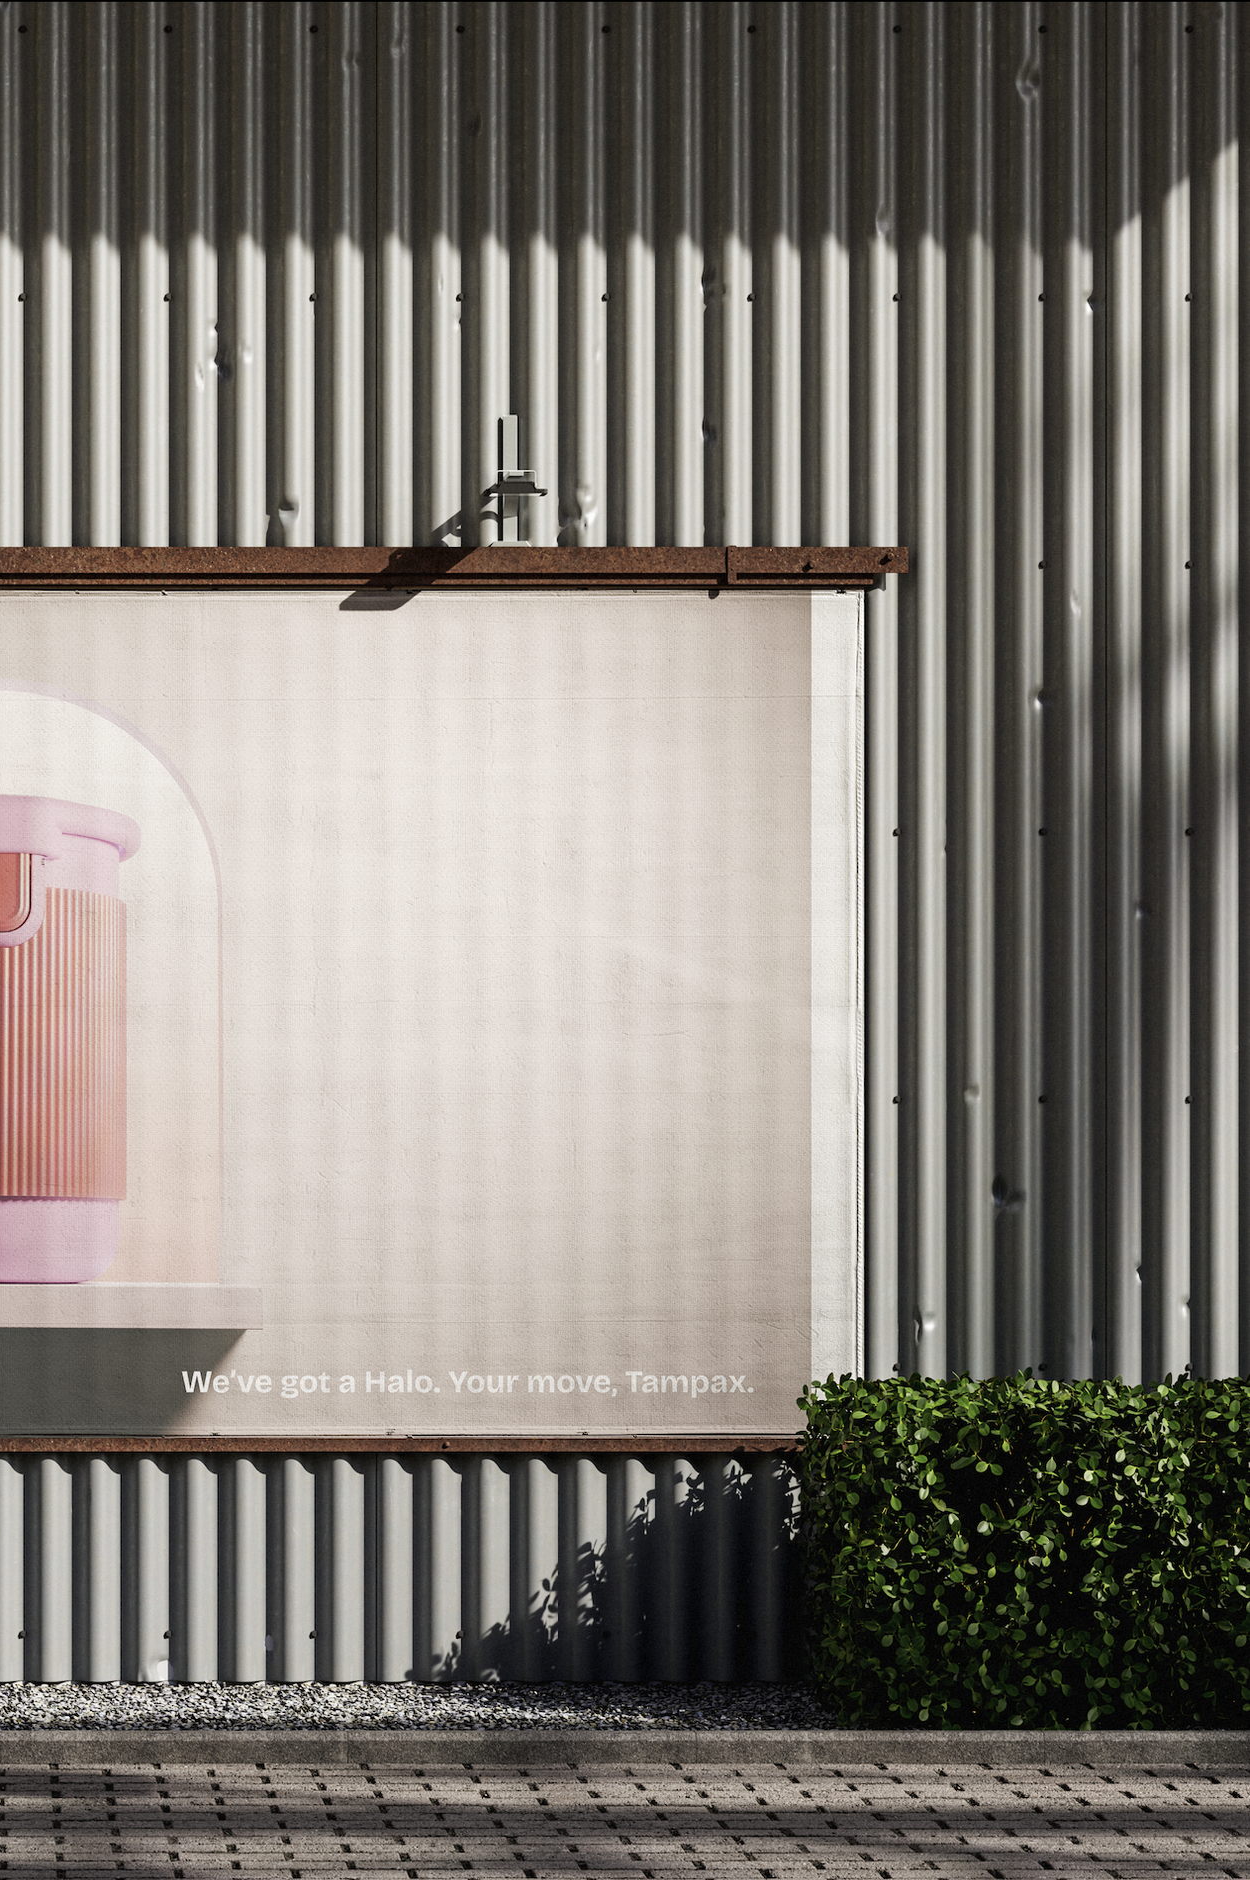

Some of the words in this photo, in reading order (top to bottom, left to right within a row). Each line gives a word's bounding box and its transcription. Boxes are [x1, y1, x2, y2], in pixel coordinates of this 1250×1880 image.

[182, 1369, 272, 1393] We've
[280, 1371, 330, 1399] got
[339, 1374, 356, 1393] a
[365, 1369, 441, 1393] Halo.
[448, 1370, 519, 1393] Your
[527, 1374, 618, 1397] move,
[625, 1370, 754, 1398] Tampax.
